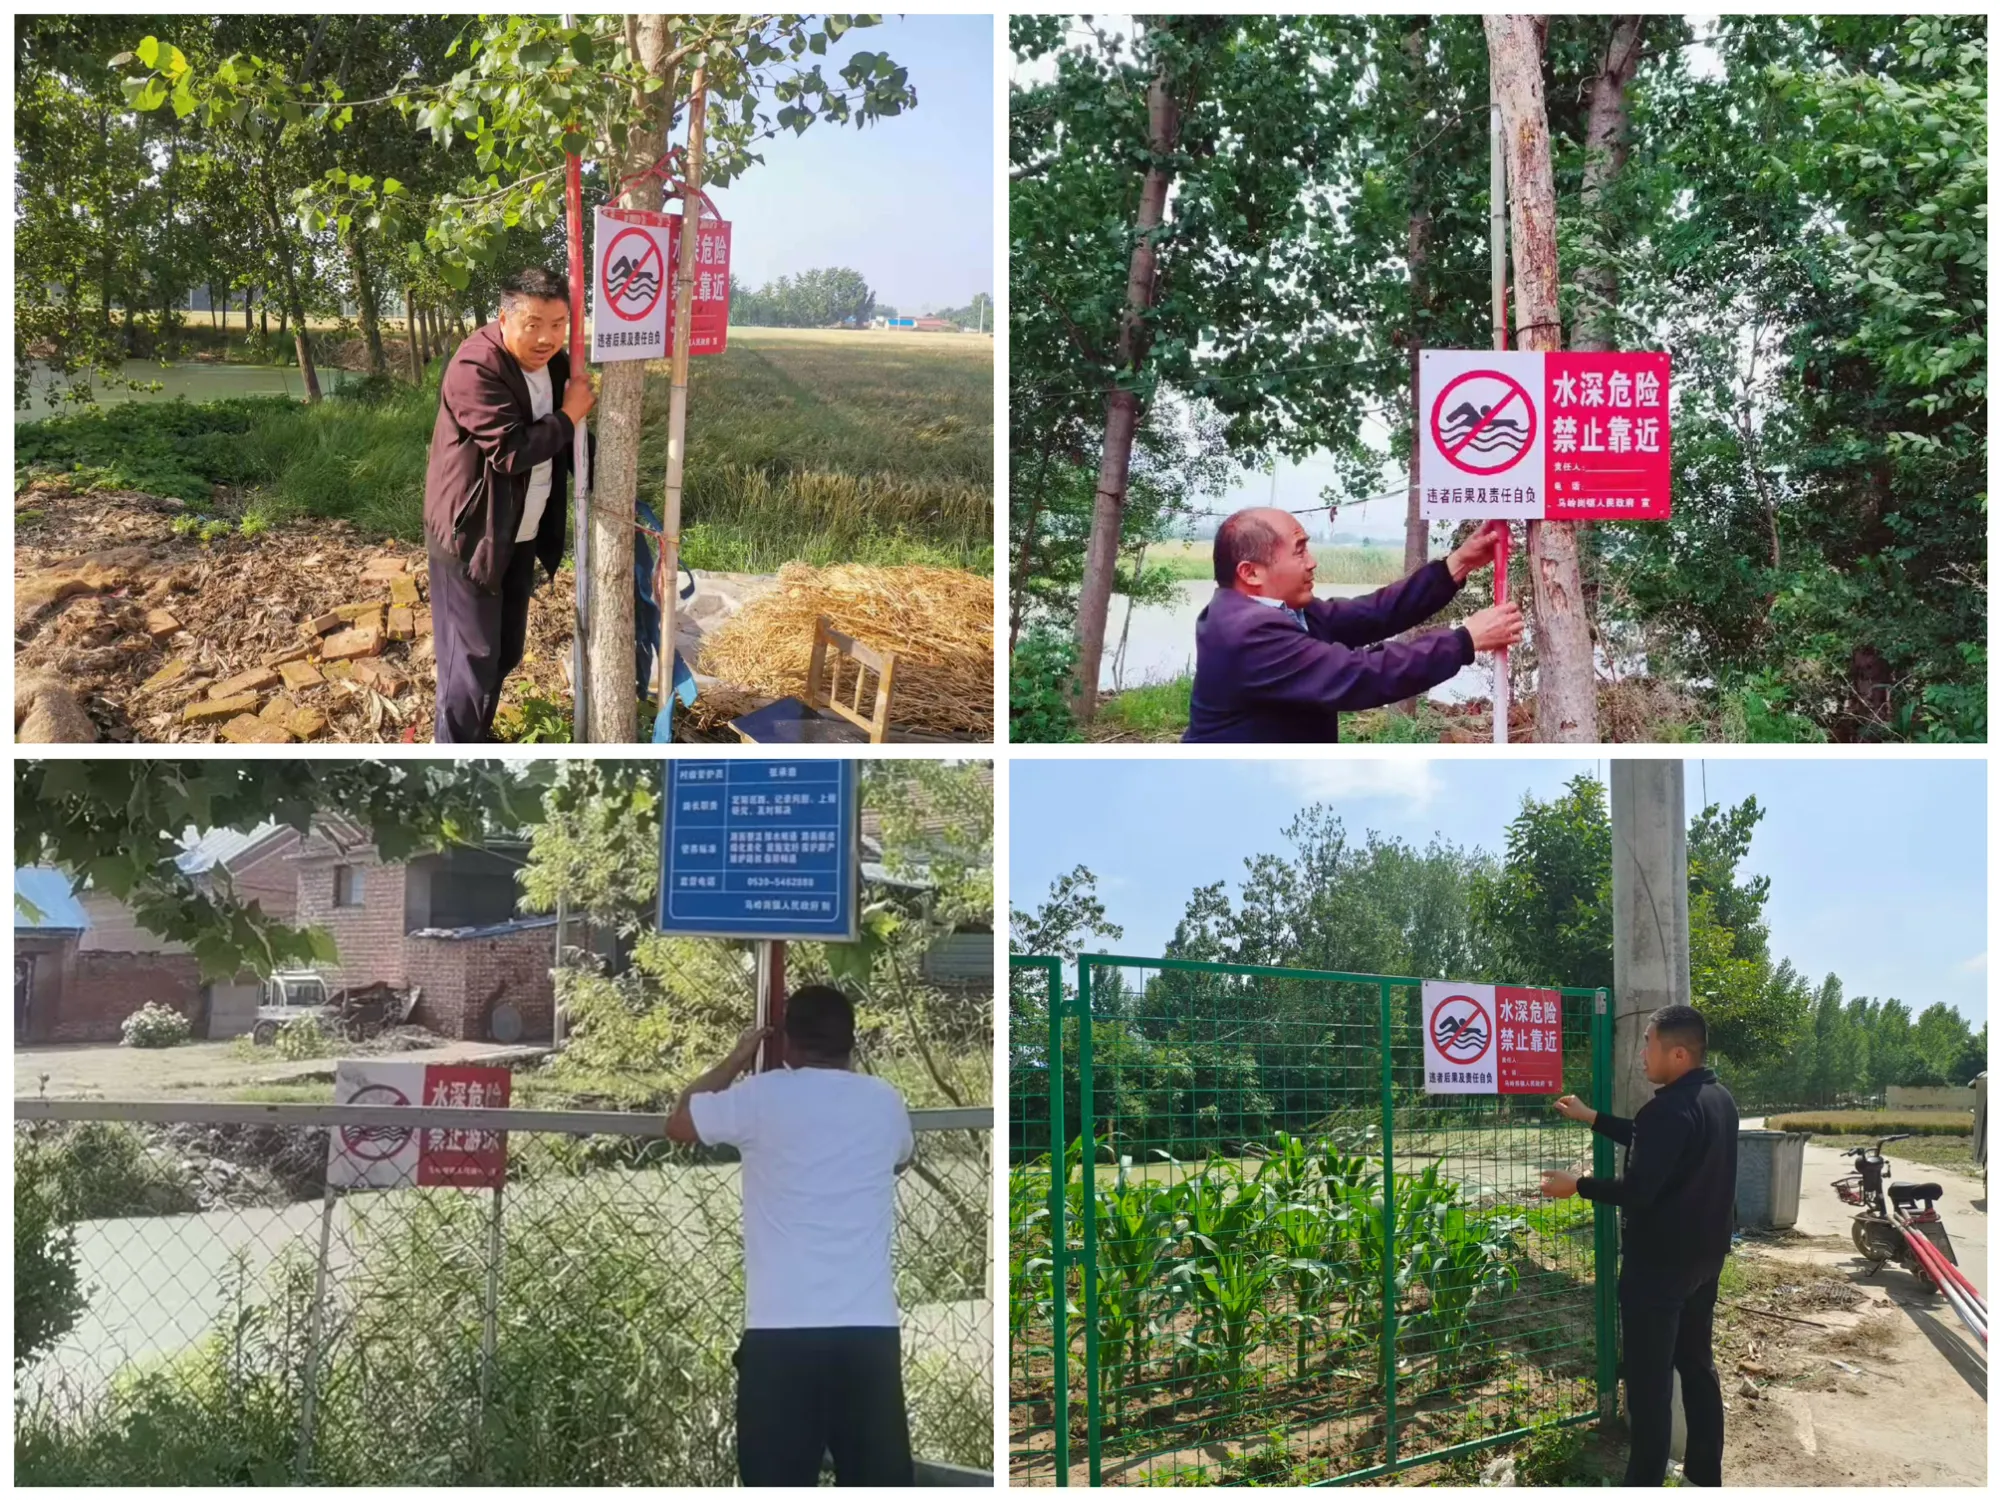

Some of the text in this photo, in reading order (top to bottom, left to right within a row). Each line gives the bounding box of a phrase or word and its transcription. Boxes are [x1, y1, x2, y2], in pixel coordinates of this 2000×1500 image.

[597, 331, 661, 348] 违者后果及责任自负
[1552, 369, 1660, 408] 水深危险
[1552, 415, 1660, 454] 禁止靠近
[1427, 486, 1536, 504] 违者后果及责任自负
[1500, 998, 1557, 1025] 水深危险
[1500, 1028, 1558, 1053] 禁止靠近
[1428, 1072, 1493, 1084] 违者后果及责任自负
[431, 1080, 502, 1108] 水深危险
